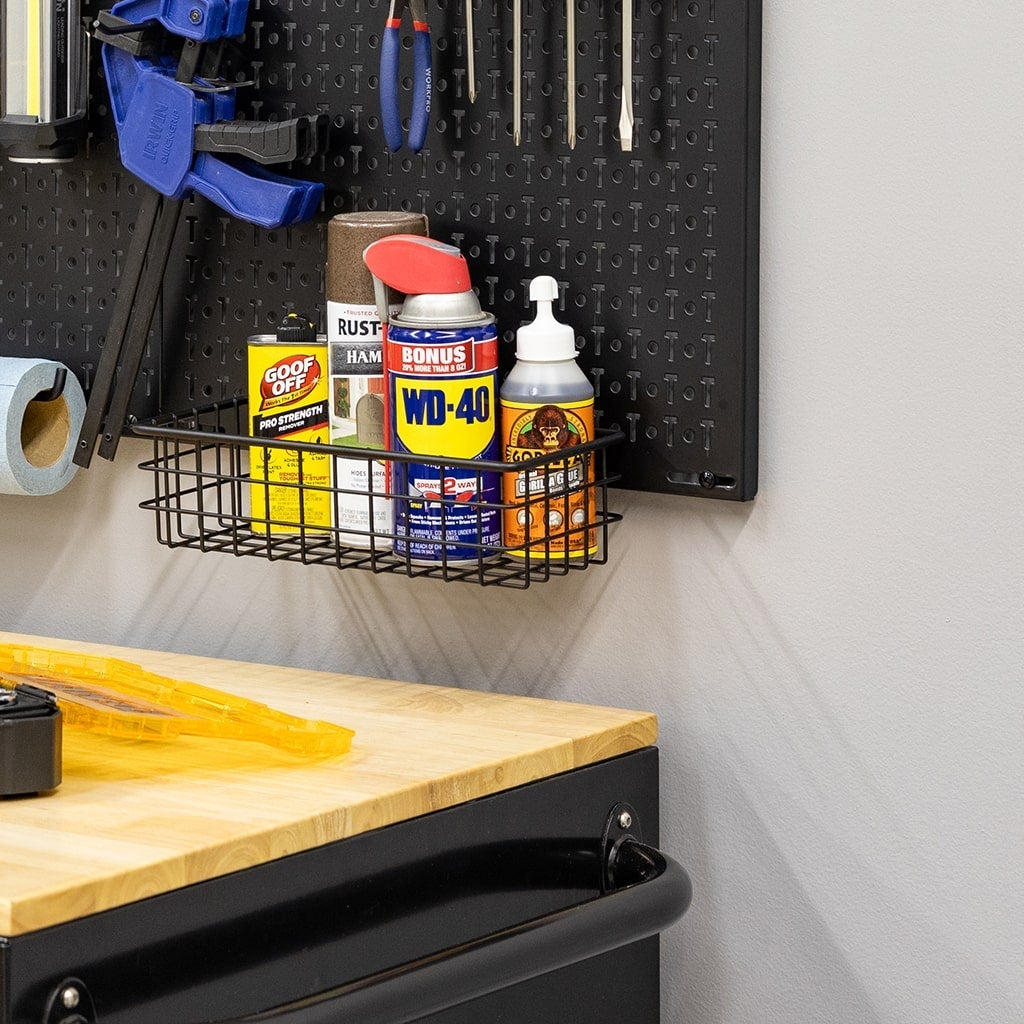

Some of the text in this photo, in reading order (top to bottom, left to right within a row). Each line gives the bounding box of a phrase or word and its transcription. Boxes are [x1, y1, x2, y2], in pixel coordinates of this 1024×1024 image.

[143, 101, 169, 161] IRWIN
[338, 318, 382, 336] RUST-
[401, 345, 466, 365] BONUS
[264, 355, 315, 383] GOOF
[414, 363, 431, 372] MORE
[433, 364, 449, 373] THAN
[271, 373, 307, 396] OFF
[401, 385, 490, 426] WD-40
[259, 404, 323, 431] PRO STRENGTH
[278, 420, 305, 432] REMOVER
[443, 478, 456, 494] 2
[457, 481, 476, 489] WAY
